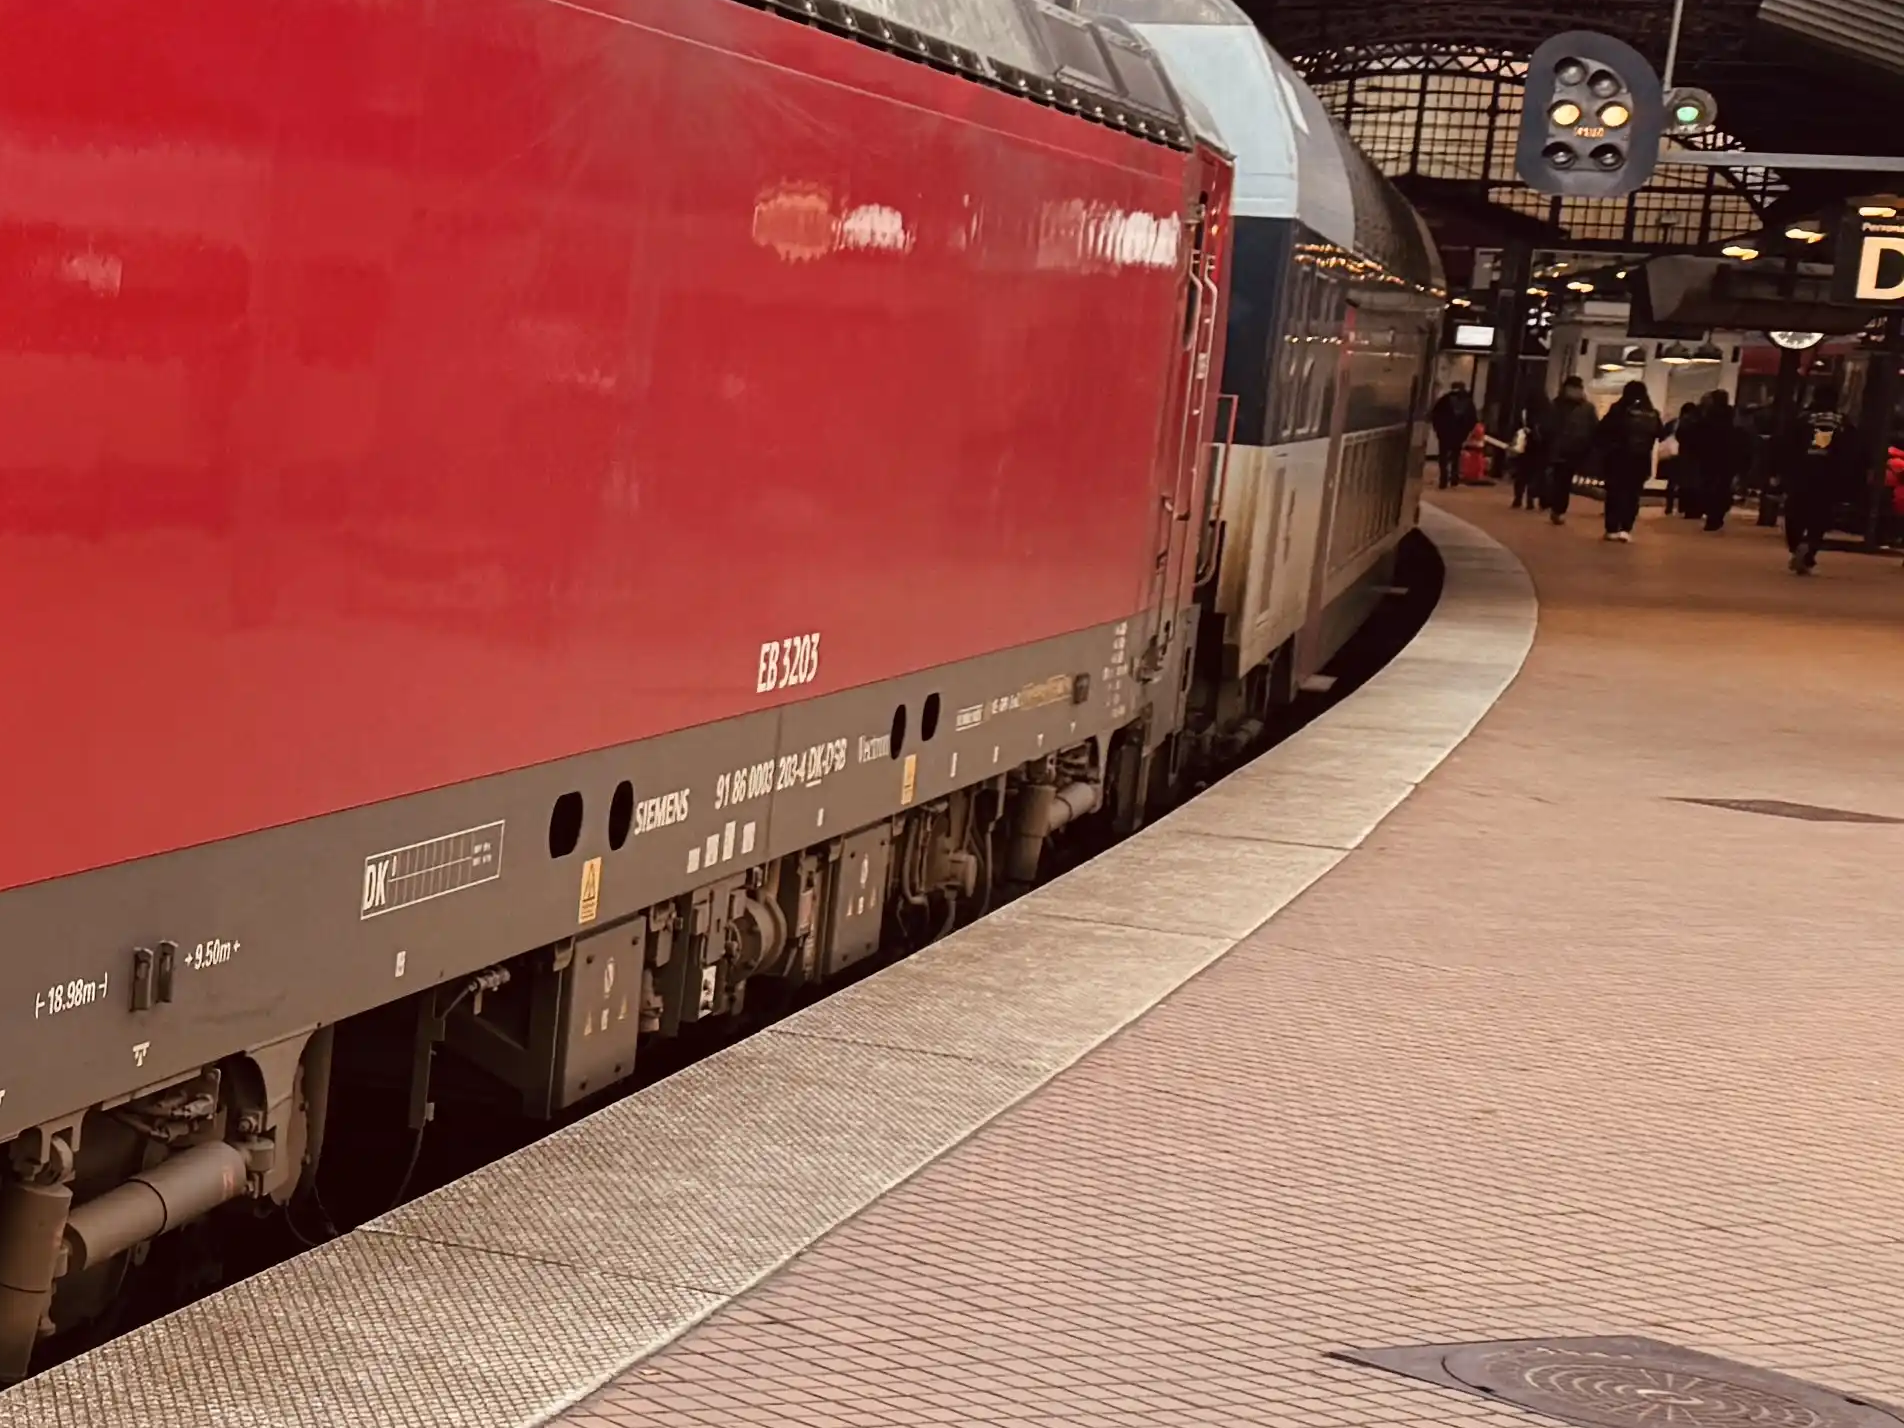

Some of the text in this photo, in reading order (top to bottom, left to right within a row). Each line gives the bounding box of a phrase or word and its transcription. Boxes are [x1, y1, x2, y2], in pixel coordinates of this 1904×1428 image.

[1855, 236, 1904, 300] D
[756, 632, 820, 693] EB 3203
[634, 788, 690, 835] SIEMENS
[714, 772, 732, 810] 91
[731, 767, 748, 805] 86
[363, 859, 390, 911] DK
[193, 938, 231, 970] 9.50m
[47, 978, 96, 1015] 18.98m
